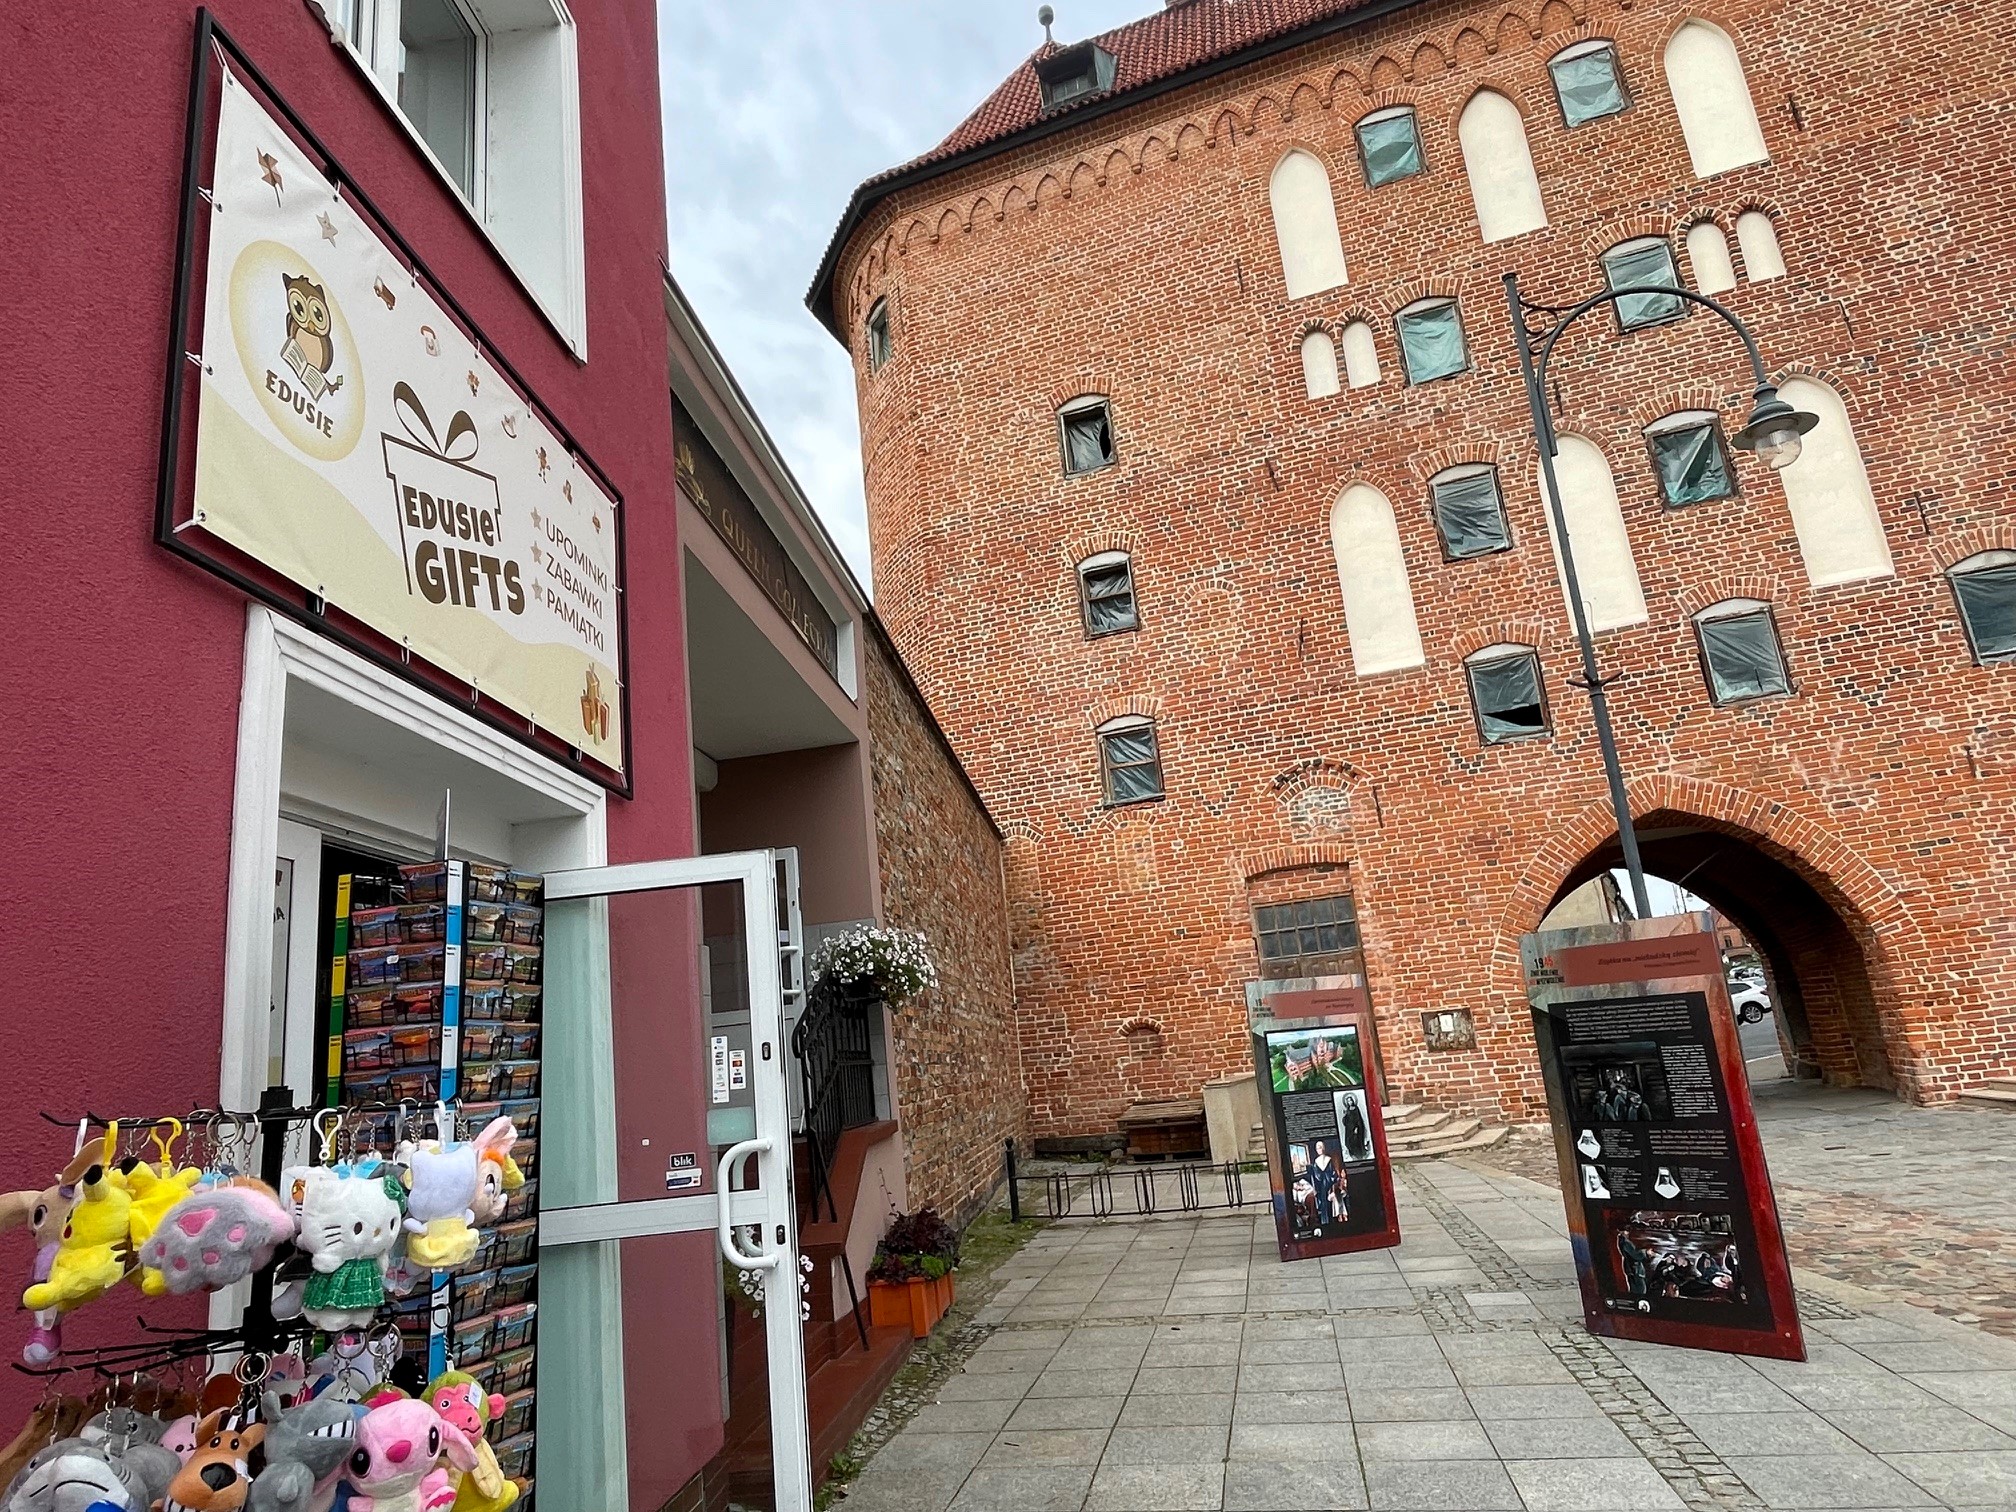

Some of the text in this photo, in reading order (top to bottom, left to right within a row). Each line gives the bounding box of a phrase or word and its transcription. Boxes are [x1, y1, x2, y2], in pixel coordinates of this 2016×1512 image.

[266, 369, 334, 439] EDUSIE
[415, 539, 526, 616] GIFTS
[546, 517, 608, 593] UPOMINKI
[546, 552, 603, 620] ZABAWKI
[547, 588, 604, 653] PAMIĄTKI
[673, 1154, 692, 1167] blik
